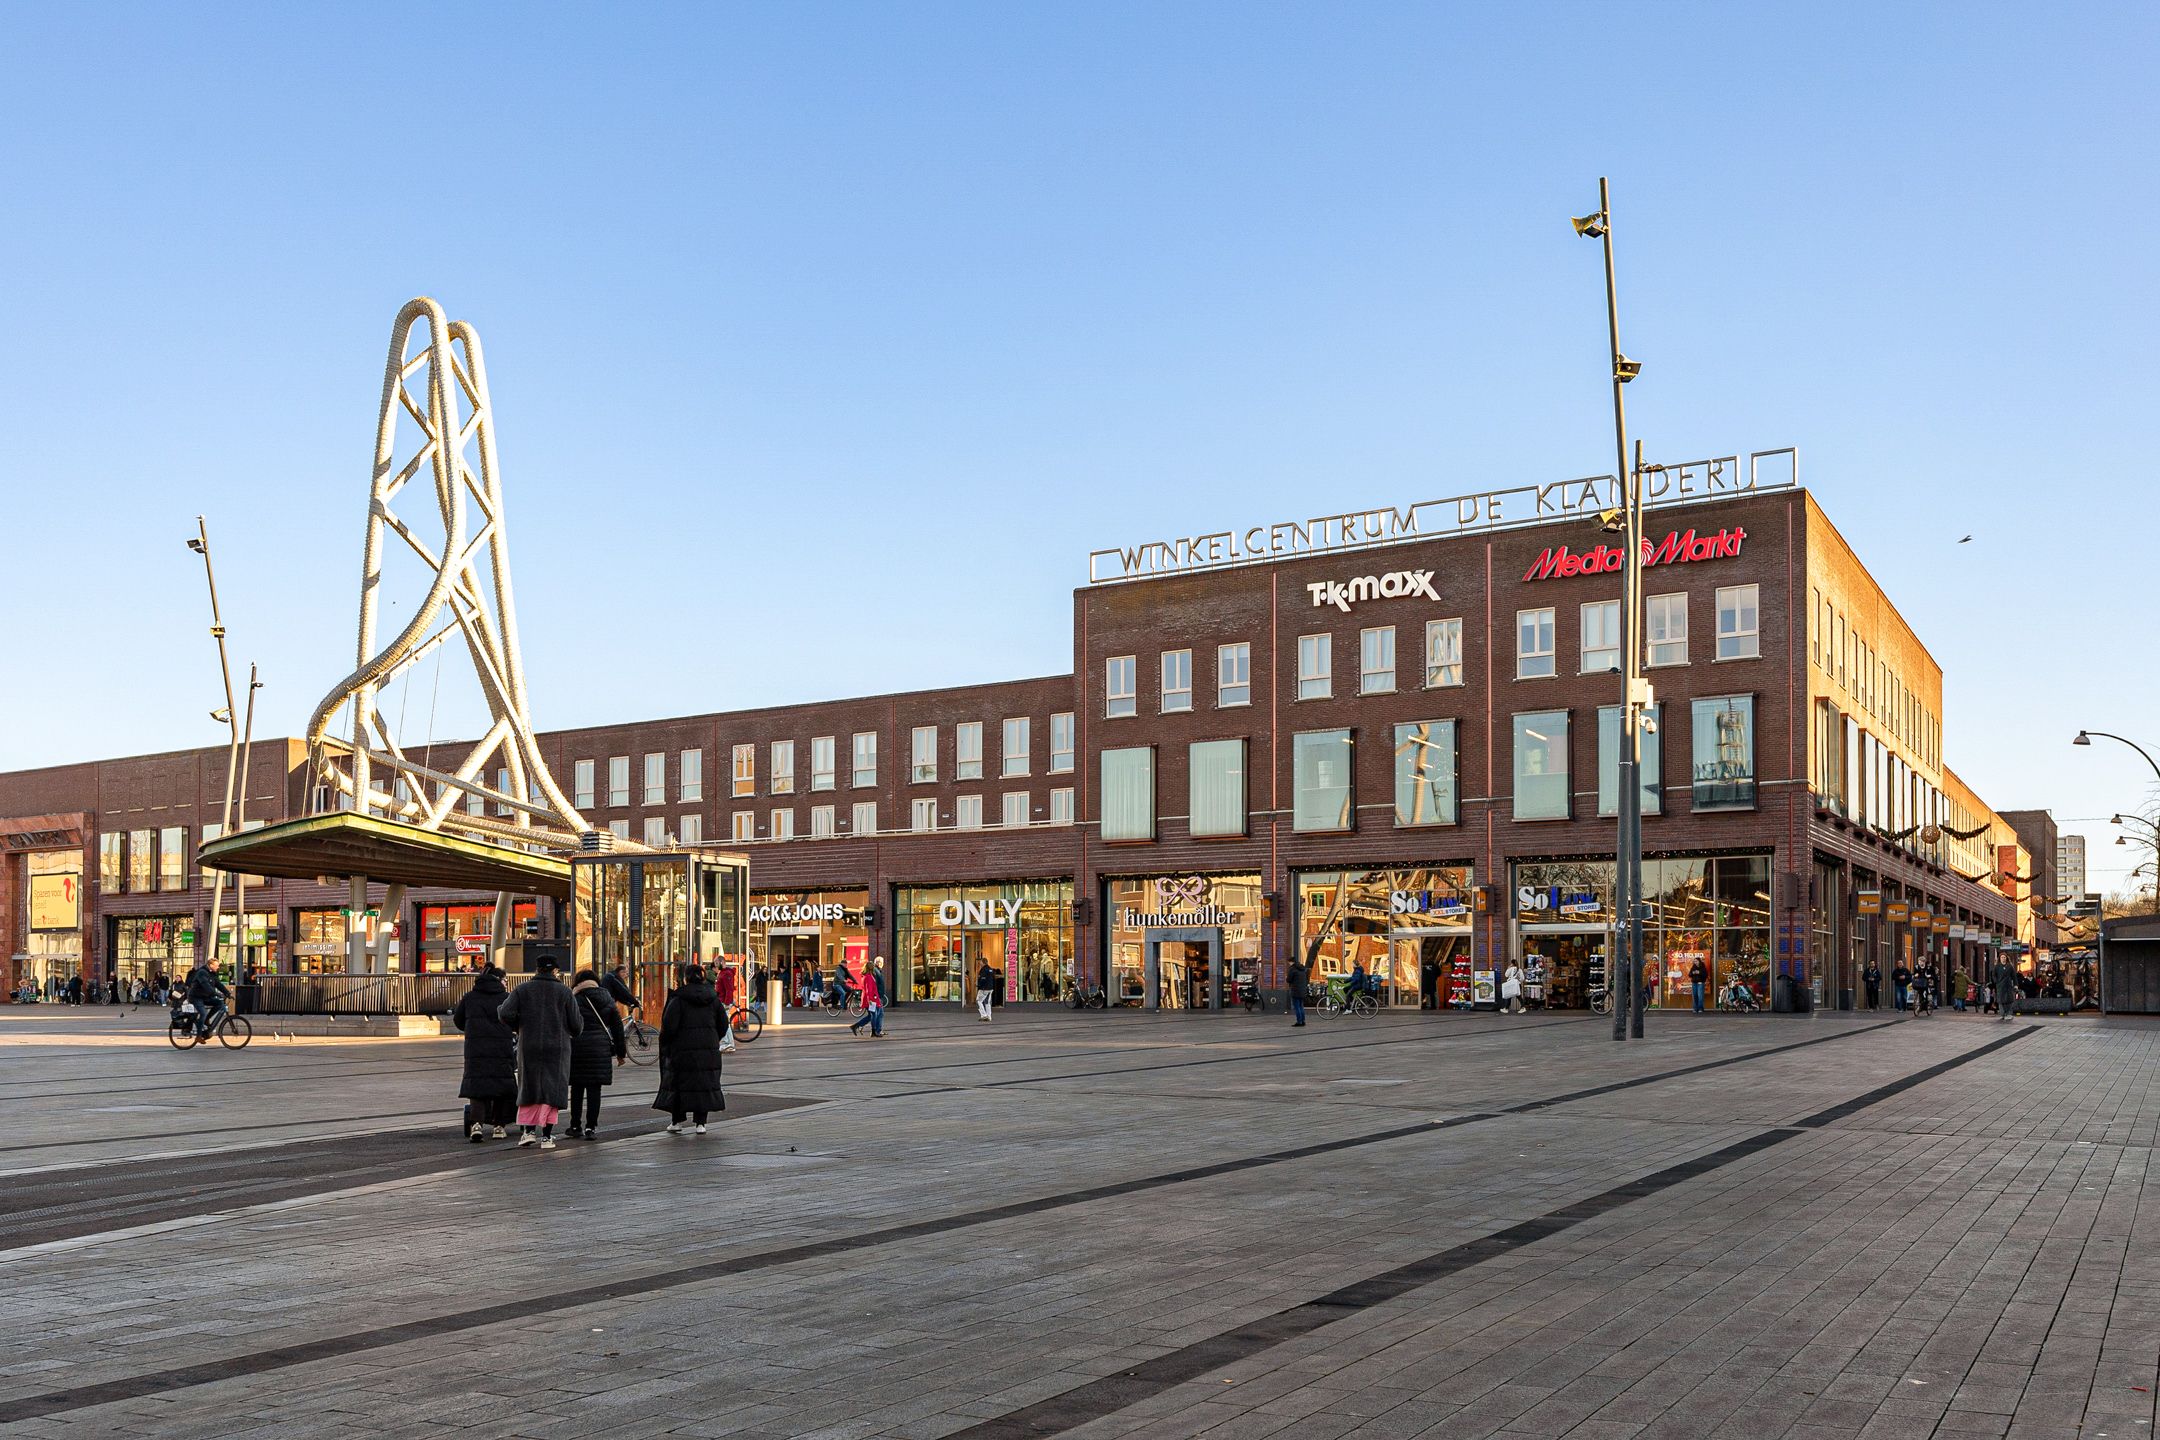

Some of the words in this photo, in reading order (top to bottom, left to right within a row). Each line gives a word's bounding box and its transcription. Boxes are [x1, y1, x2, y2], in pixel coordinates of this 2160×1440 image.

[1120, 506, 1417, 572] WINKELCENTRUM
[1458, 493, 1503, 524] DE
[1522, 544, 1624, 582] Media
[1646, 526, 1748, 567] Markt
[750, 903, 843, 922] ACK&JONES
[939, 898, 1023, 926] ONLY
[253, 932, 264, 941] kpn
[1008, 931, 1016, 951] SALE
[1008, 955, 1016, 975] SALE
[1008, 979, 1016, 1001] SALE
